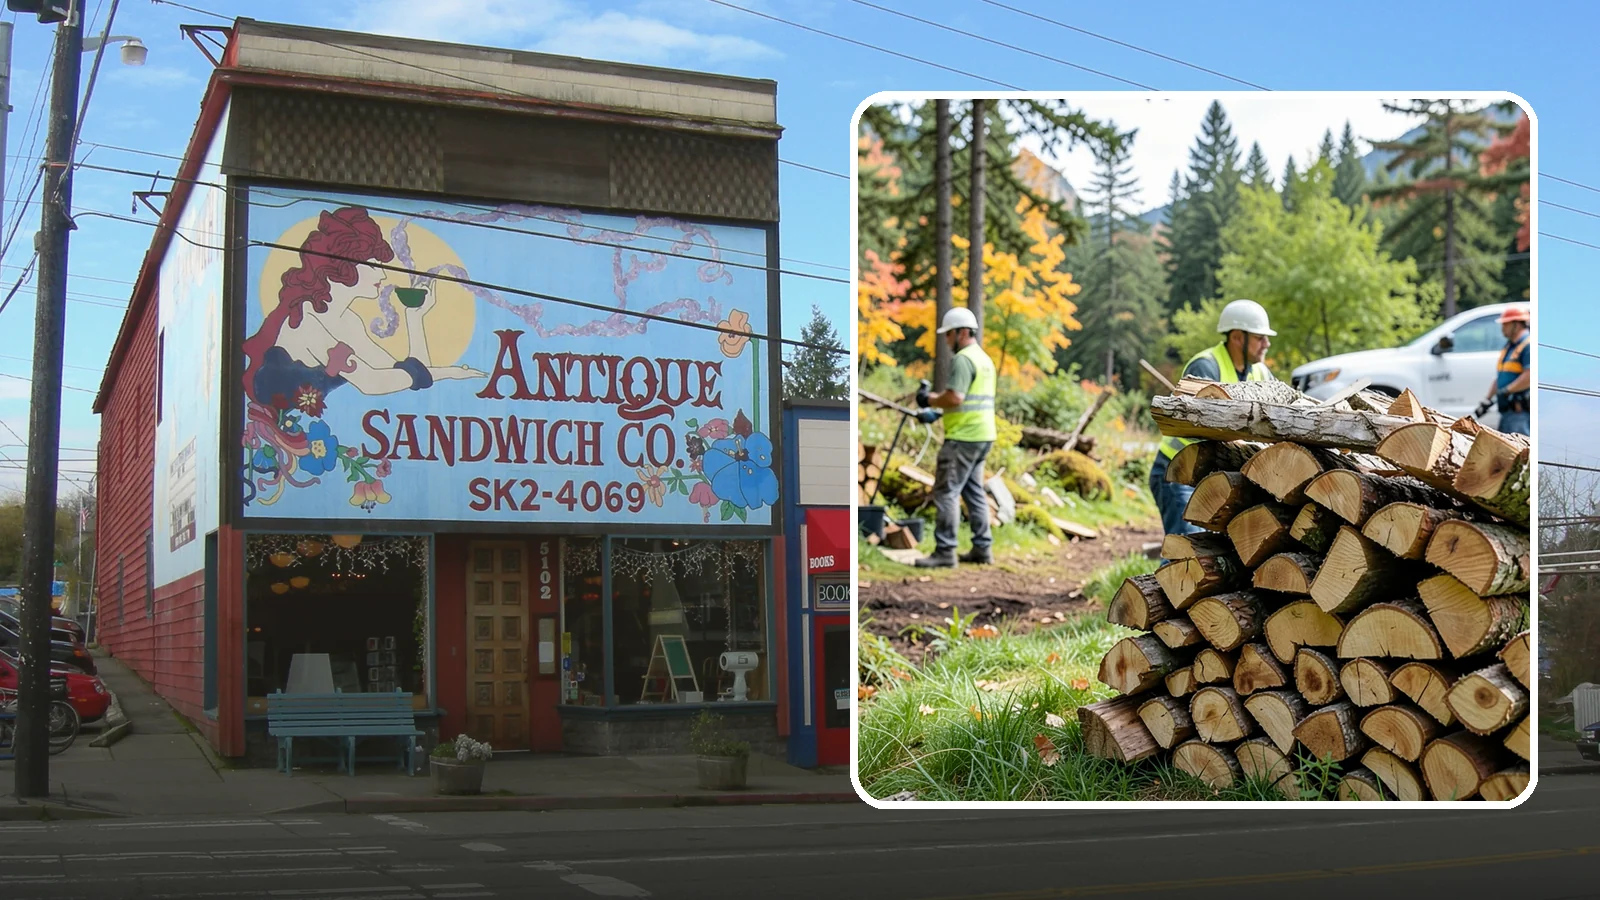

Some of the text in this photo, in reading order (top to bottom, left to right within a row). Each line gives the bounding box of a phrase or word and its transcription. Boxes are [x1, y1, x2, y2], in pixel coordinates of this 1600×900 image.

[476, 329, 723, 421] ANTIQUE
[361, 408, 685, 469] SANDWICH CO.
[468, 477, 645, 512] SK2-4069
[540, 541, 552, 600] 5102
[809, 555, 835, 569] BOOKS
